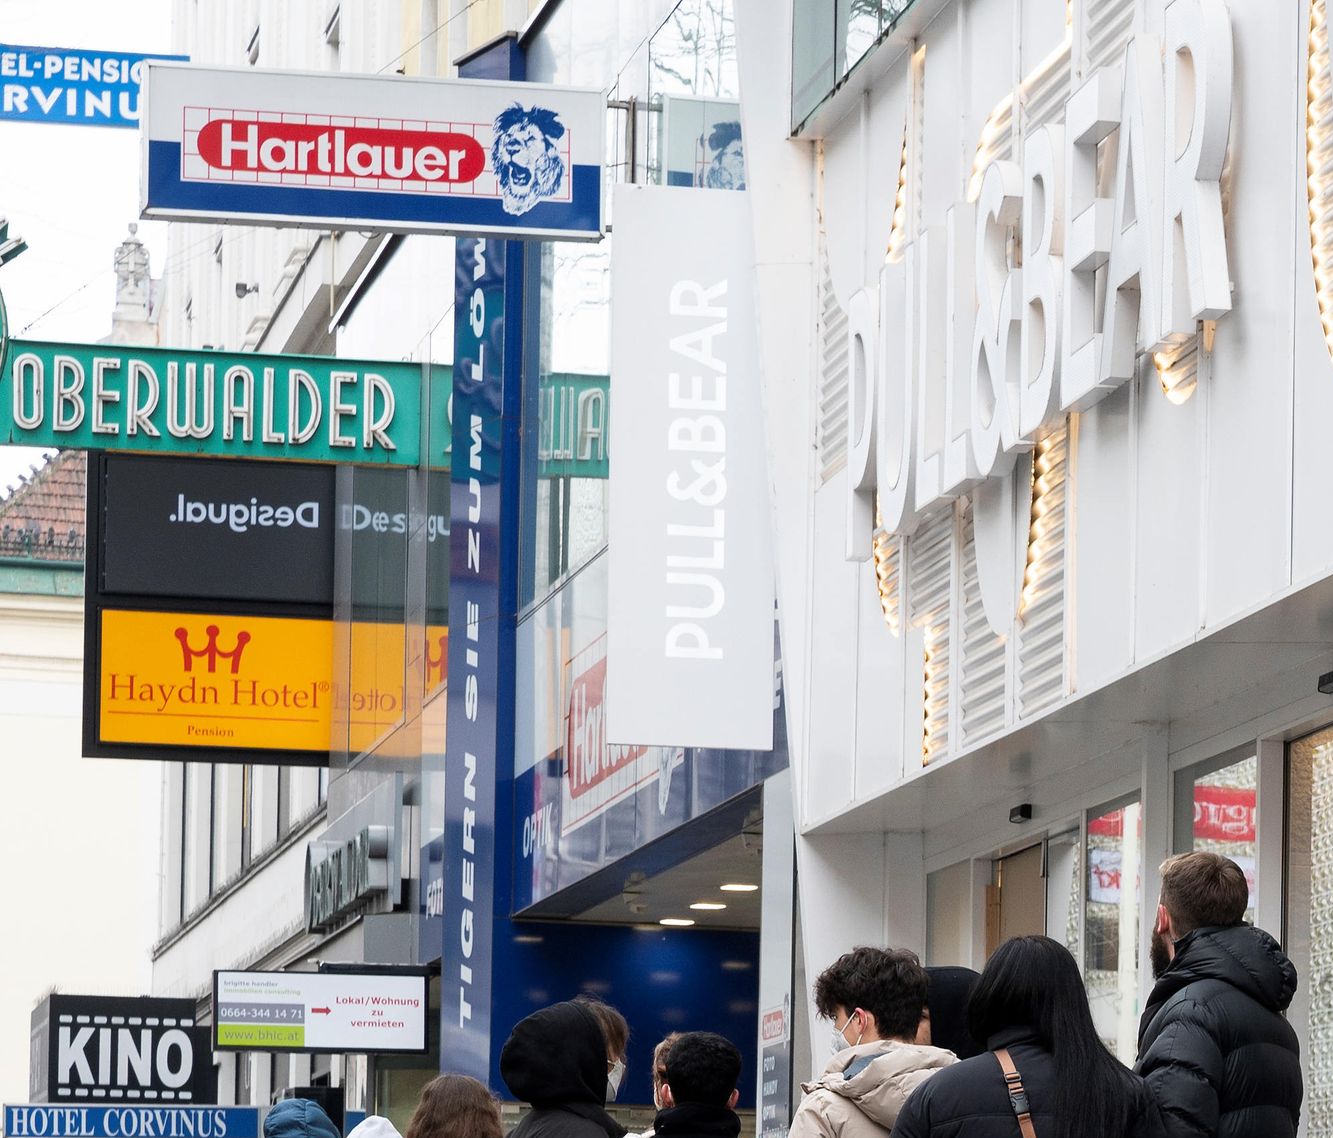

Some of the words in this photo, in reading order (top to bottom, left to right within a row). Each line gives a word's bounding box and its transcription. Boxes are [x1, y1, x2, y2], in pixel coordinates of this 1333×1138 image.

[220, 122, 468, 181] Hartlauer
[845, 0, 1234, 562] PULL&BEAR
[11, 351, 398, 451] OBERWALDER
[467, 414, 483, 573] ZUM
[665, 278, 728, 660] PULL&BEAR
[465, 600, 479, 722] SIE
[108, 674, 220, 712] Haydn
[187, 725, 234, 737] Pension
[523, 803, 553, 858] OPTIK
[459, 752, 477, 1029] TIGERN
[220, 1007, 270, 1018] 0664-344
[275, 1008, 287, 1019] 14
[291, 1009, 303, 1019] 71
[336, 996, 420, 1007] Lokal/Wohnung
[351, 1019, 405, 1028] vermieten
[58, 1026, 193, 1088] KINO
[763, 1056, 776, 1073] FOTO
[10, 1107, 95, 1137] HOTEL
[103, 1108, 227, 1138] CORVINUS
[763, 1104, 776, 1121] OPTIK
